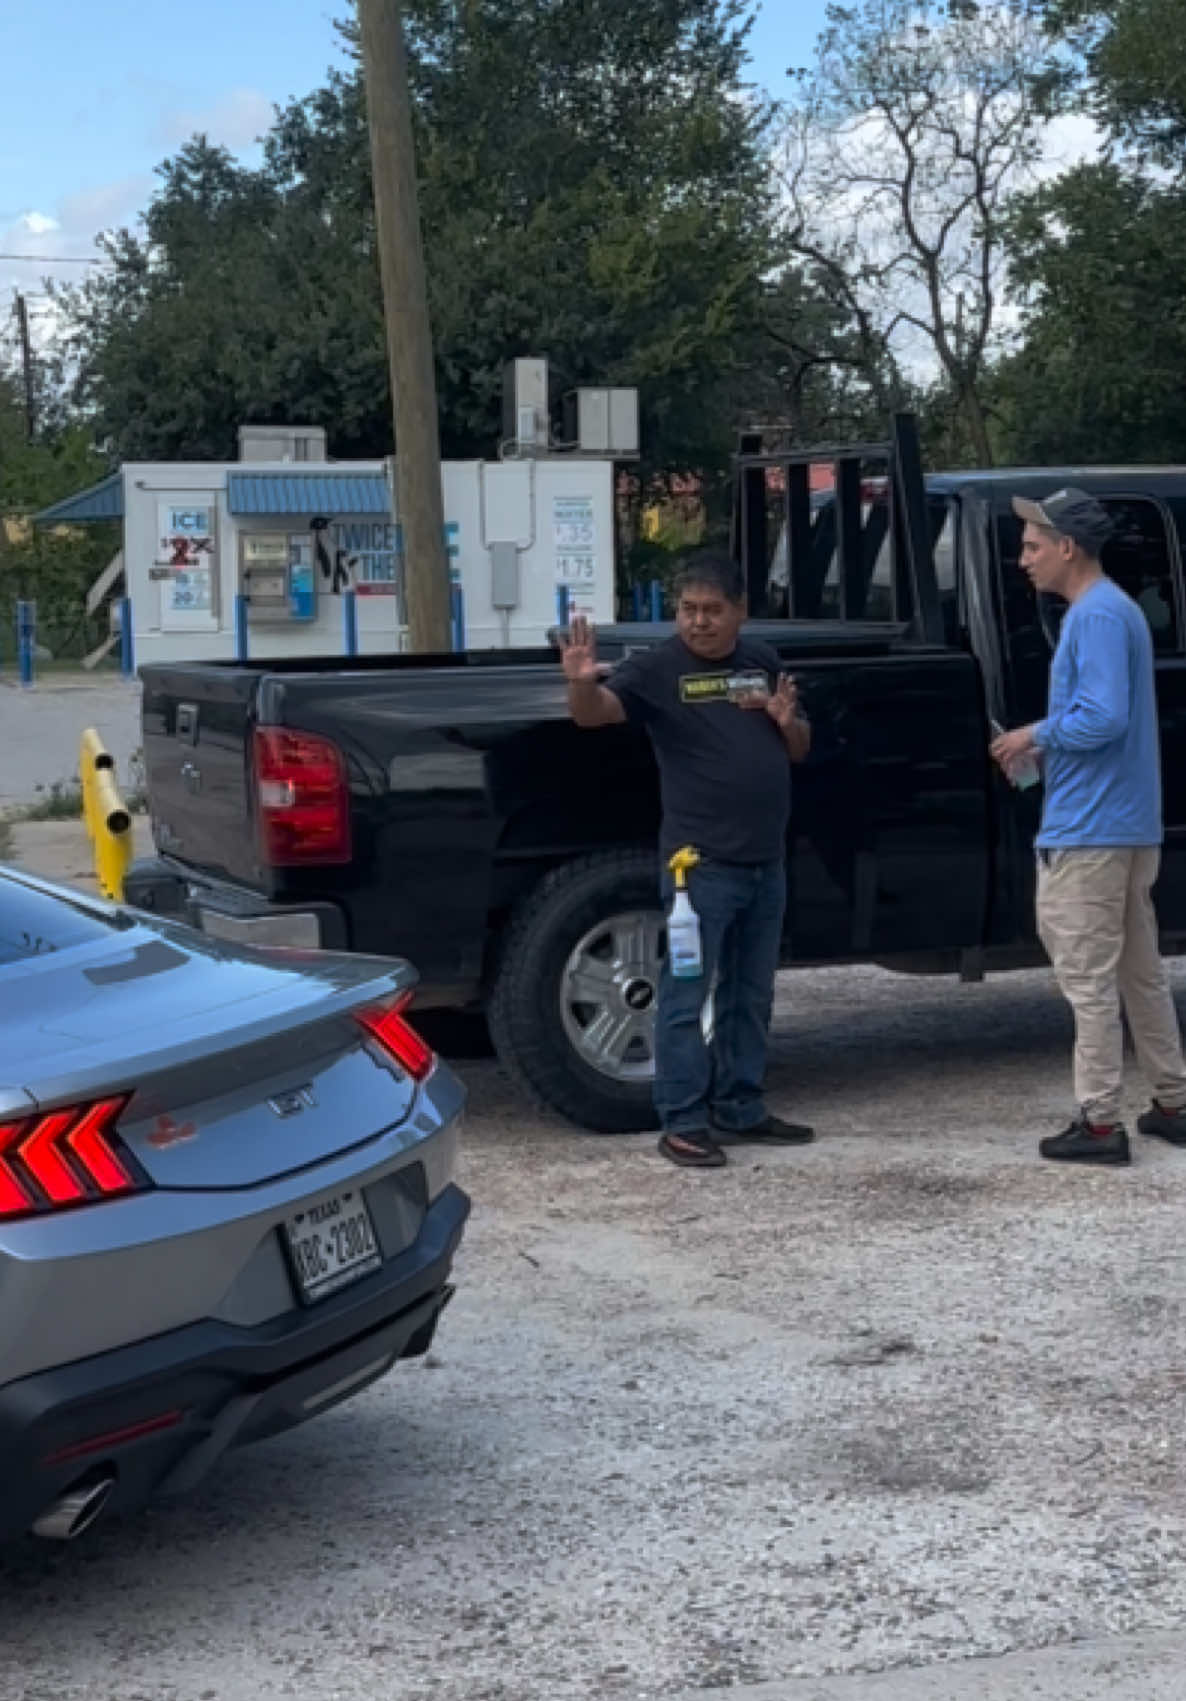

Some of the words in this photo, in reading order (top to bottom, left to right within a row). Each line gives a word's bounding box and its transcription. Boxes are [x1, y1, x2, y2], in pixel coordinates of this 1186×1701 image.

[172, 511, 209, 531] ICE
[330, 522, 394, 552] TWICE
[361, 555, 397, 581] THE
